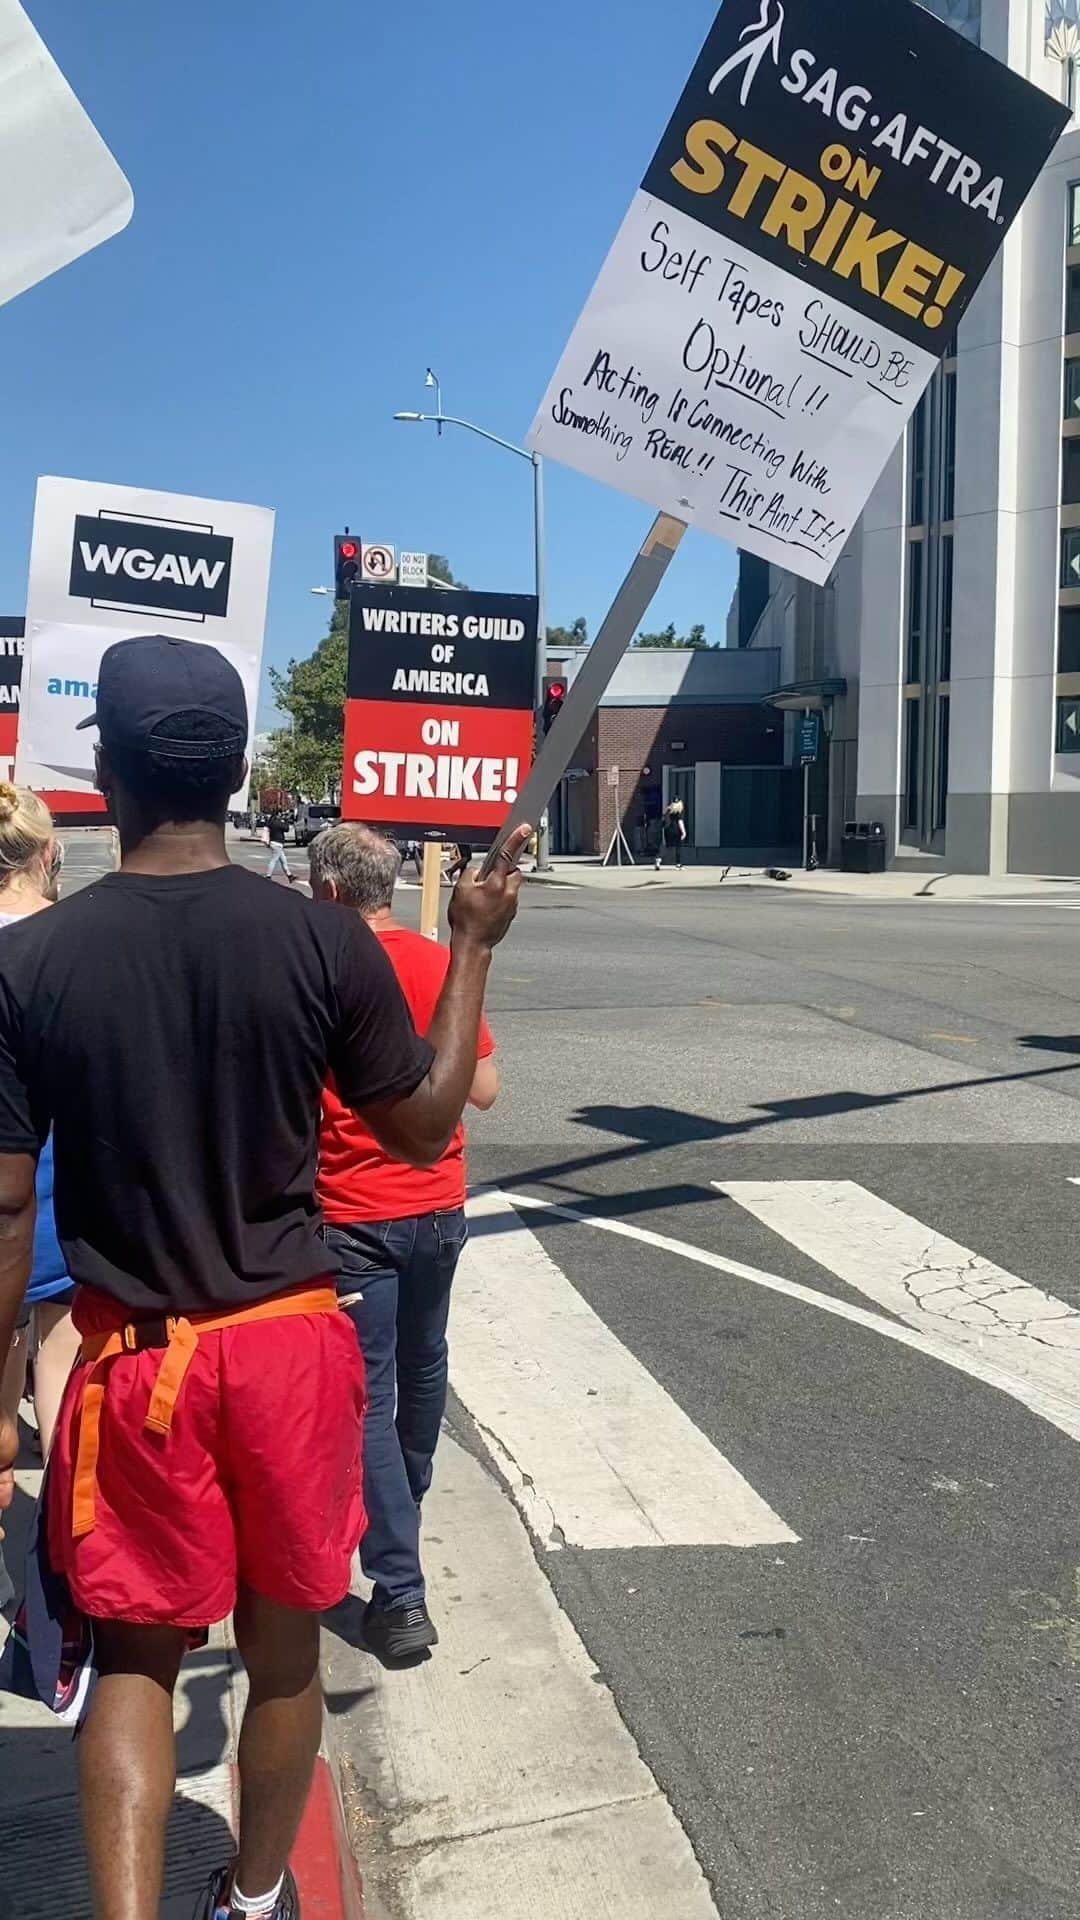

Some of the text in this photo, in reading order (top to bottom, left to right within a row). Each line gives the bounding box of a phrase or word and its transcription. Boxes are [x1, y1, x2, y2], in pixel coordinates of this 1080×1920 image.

[820, 143, 882, 200] ON
[670, 119, 966, 328] STRIKE!
[641, 221, 711, 293] Self
[718, 258, 784, 327] Tapes
[879, 351, 914, 388] BE
[552, 388, 634, 462] Something
[583, 349, 661, 424] Acting
[687, 399, 785, 478] Connecting
[790, 450, 832, 495] With
[719, 463, 763, 517] This
[79, 541, 226, 589] WGAW
[362, 608, 525, 642] WRITERS GUILD
[431, 644, 455, 664] OF
[392, 669, 489, 697] AMERICA
[421, 718, 460, 747] ON
[353, 750, 519, 804] STRIKE!
